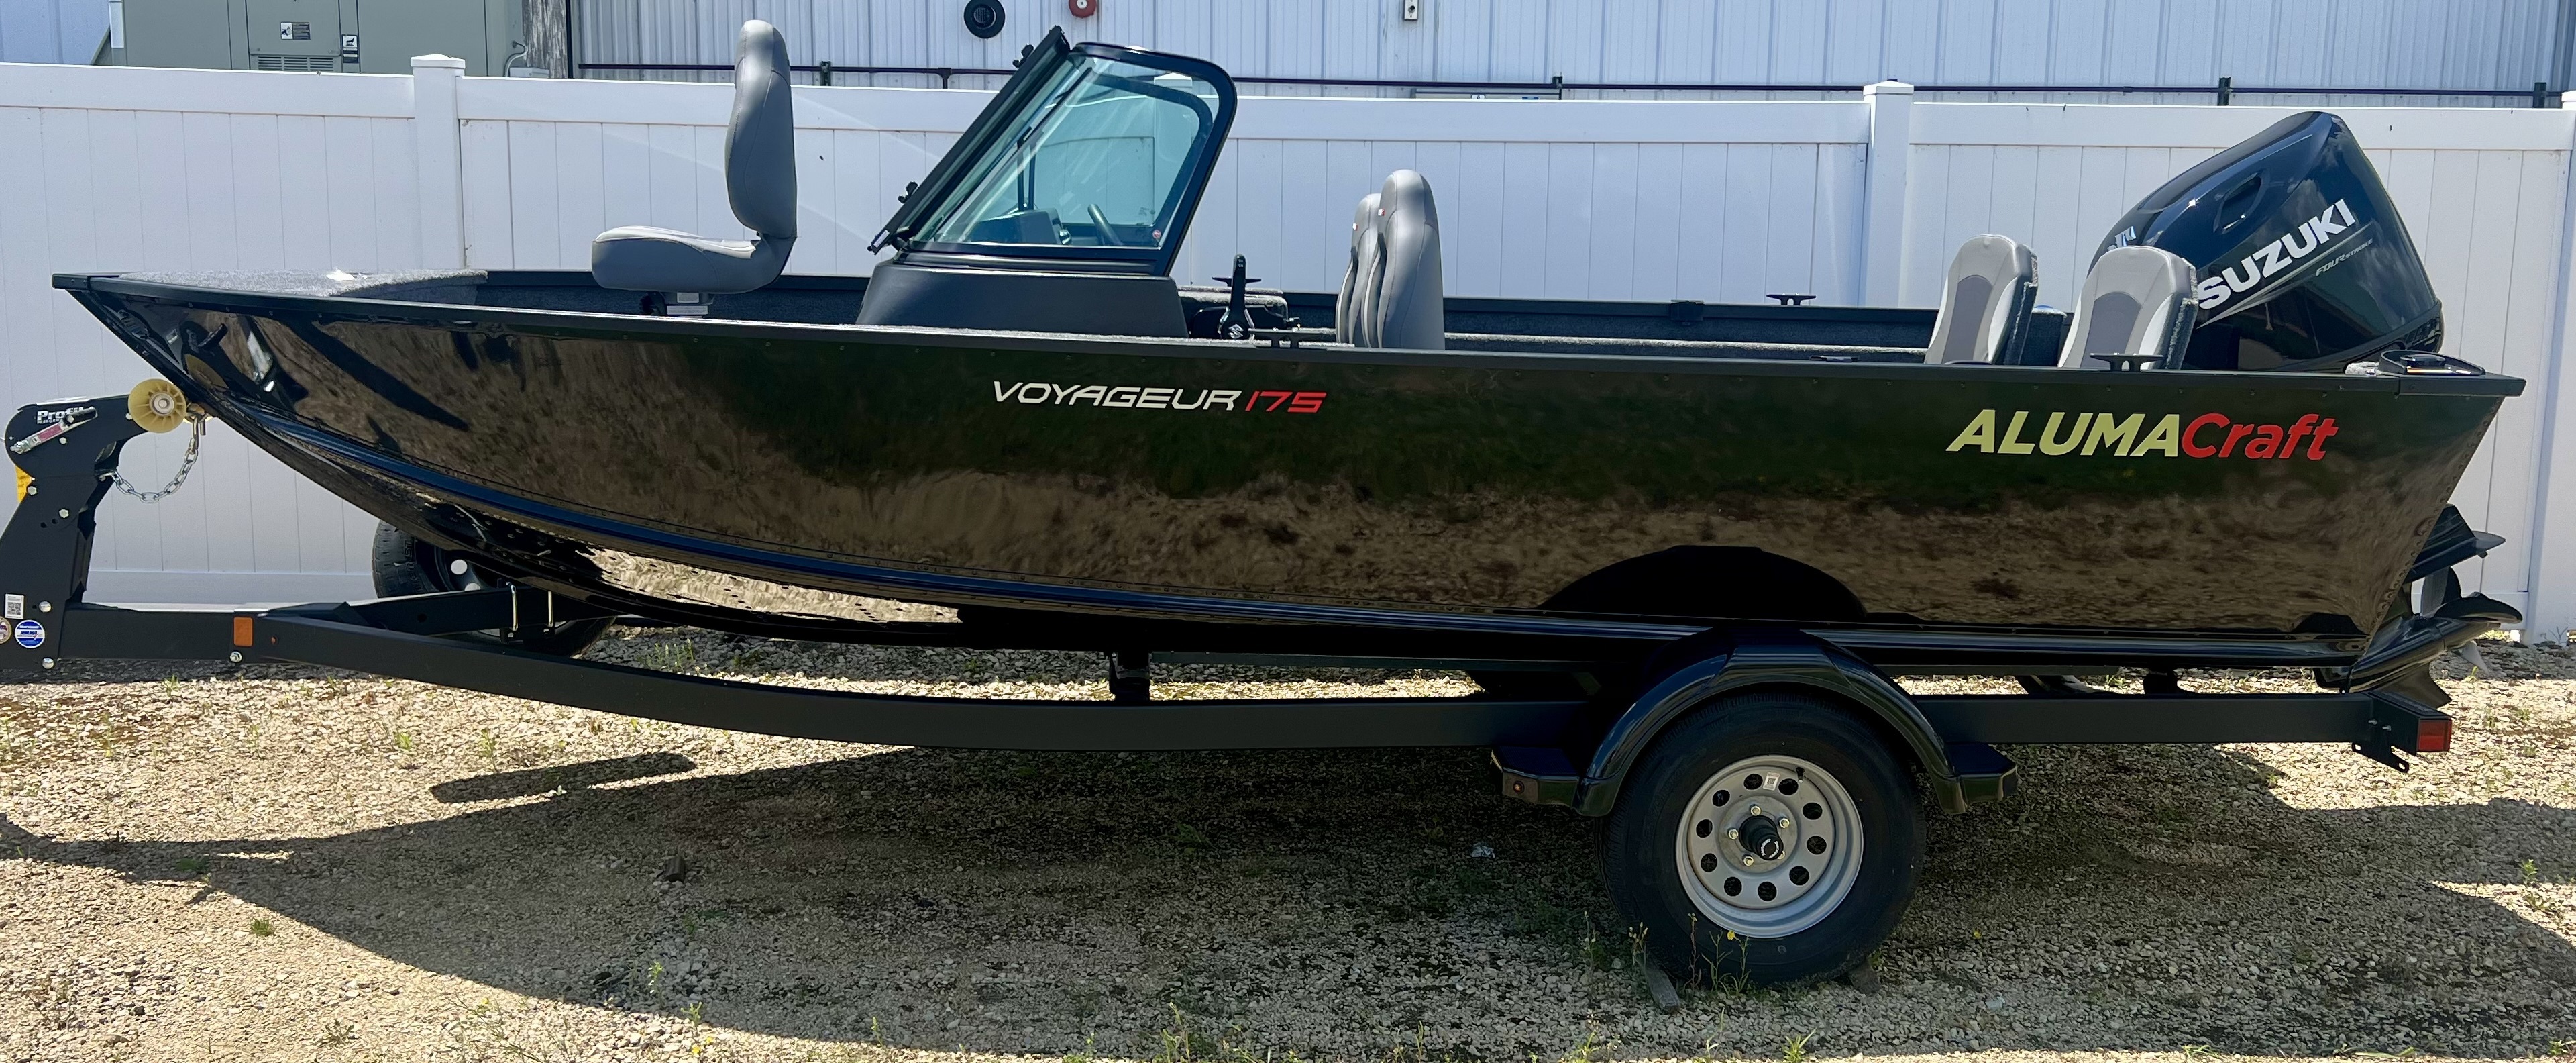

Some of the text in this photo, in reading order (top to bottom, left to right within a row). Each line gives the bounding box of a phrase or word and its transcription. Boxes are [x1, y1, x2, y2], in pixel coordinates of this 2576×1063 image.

[2198, 199, 2355, 309] SUZUKI
[994, 381, 1327, 413] VOYAGEUR 175
[1945, 409, 2339, 460] ALUMACraft
